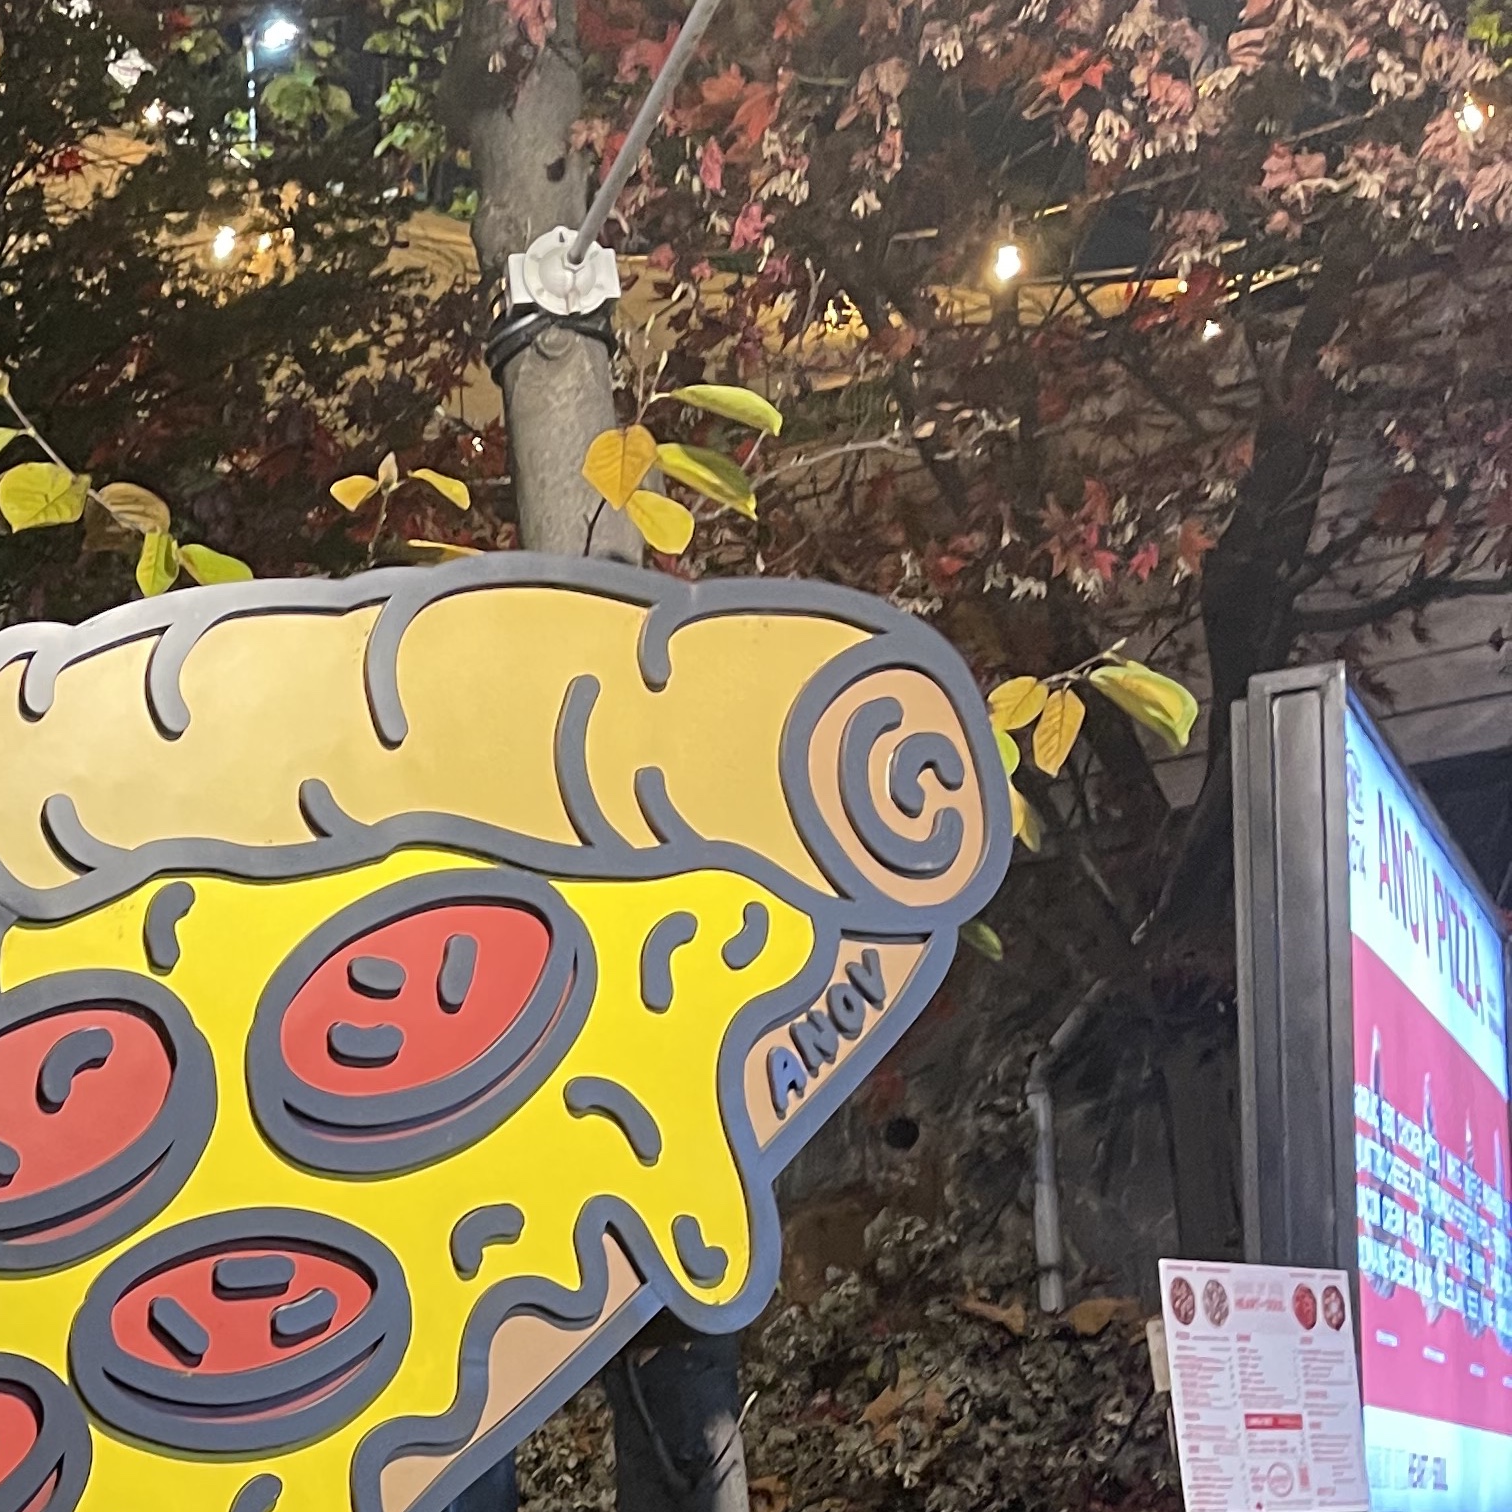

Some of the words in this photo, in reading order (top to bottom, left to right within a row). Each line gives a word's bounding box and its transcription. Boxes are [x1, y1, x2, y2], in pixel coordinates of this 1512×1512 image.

[1378, 788, 1431, 959] ANOV
[1432, 869, 1485, 1026] PIZZA
[766, 948, 887, 1120] ANOV
